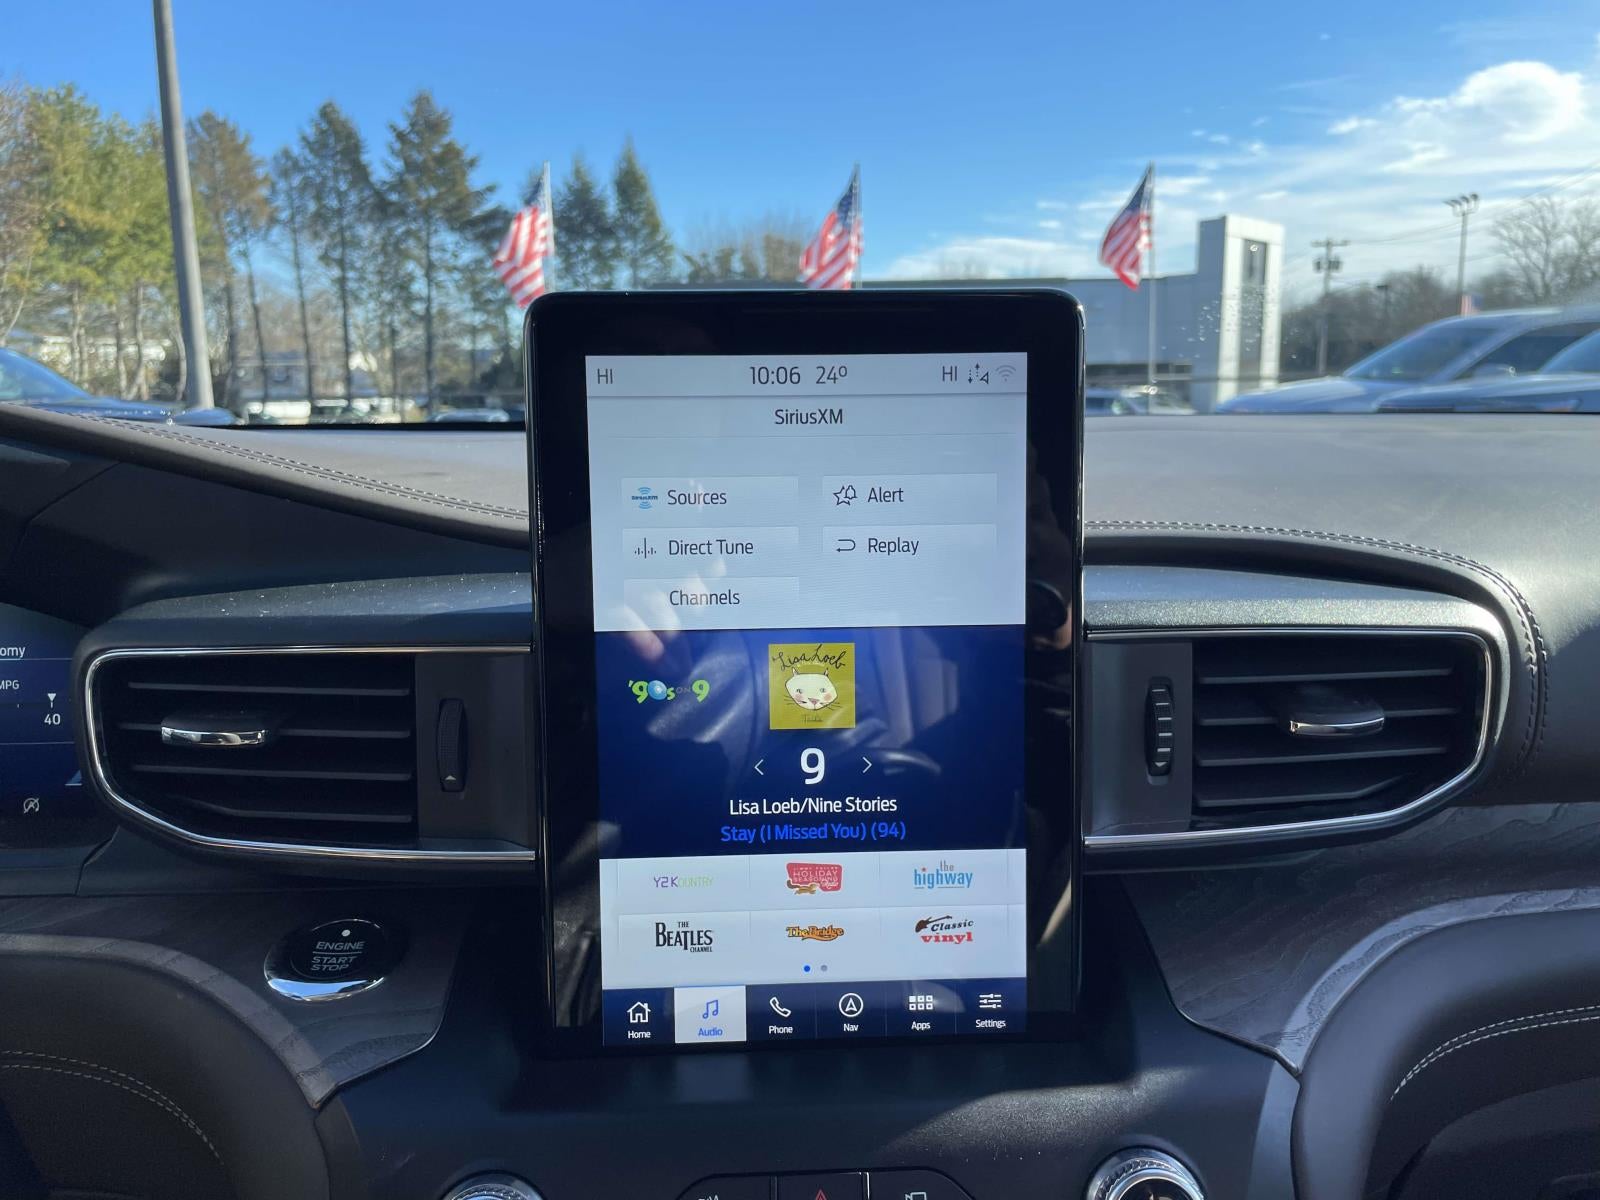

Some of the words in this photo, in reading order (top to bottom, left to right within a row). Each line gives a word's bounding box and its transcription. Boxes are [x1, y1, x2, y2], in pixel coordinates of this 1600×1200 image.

[597, 368, 613, 385] HI
[750, 366, 801, 385] 10:06
[942, 366, 958, 382] HI
[774, 408, 844, 425] SiriusXM
[667, 489, 727, 505] Sources
[867, 487, 905, 503] Alert
[668, 539, 712, 555] Direct
[716, 539, 754, 555] Tune
[868, 536, 920, 556] Replay
[669, 589, 740, 606] Channels
[691, 679, 711, 702] 9
[44, 713, 61, 725] 40
[800, 747, 825, 785] 9
[729, 799, 760, 815] Lisa
[763, 797, 842, 814] Loeb/Nine
[845, 796, 898, 813] Stories
[720, 825, 756, 844] Stay
[760, 824, 771, 843] (I
[775, 823, 828, 840] Missed
[831, 822, 867, 841] You)
[871, 821, 906, 841] (94)
[793, 869, 838, 878] HOLIDAY
[940, 860, 954, 872] the
[914, 867, 973, 889] highway
[931, 919, 975, 932] Classic
[655, 922, 714, 951] BEATLES
[921, 931, 974, 945] vinyl
[316, 941, 366, 951] ENGINE
[310, 963, 350, 972] STOP
[311, 955, 358, 964] START
[698, 1027, 723, 1037] Audio
[768, 1025, 793, 1035] Phone
[843, 1023, 859, 1032] Nav
[911, 1021, 931, 1031] Apps
[975, 1019, 1006, 1029] Settings
[627, 1030, 651, 1039] Home
